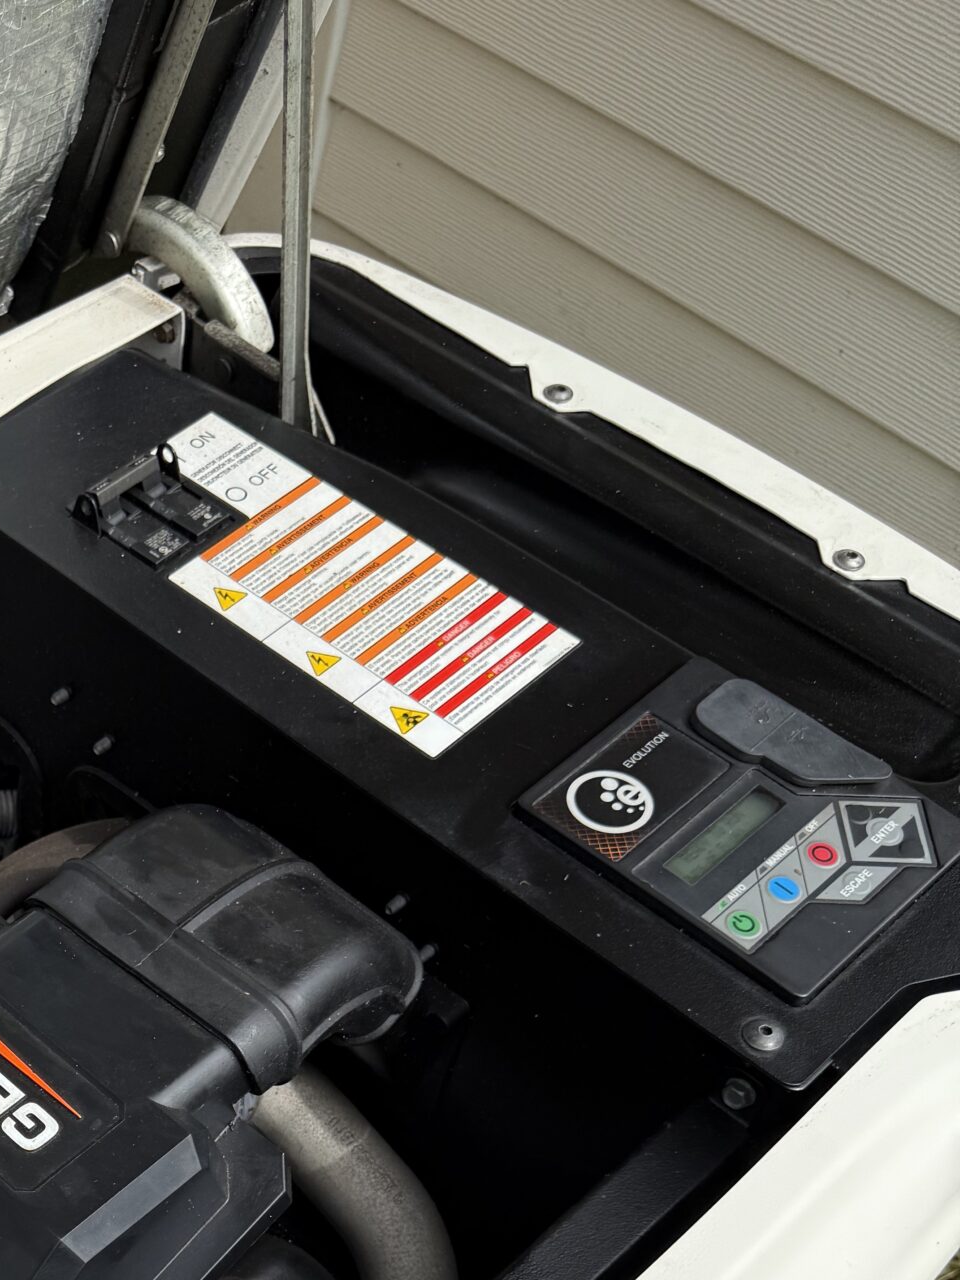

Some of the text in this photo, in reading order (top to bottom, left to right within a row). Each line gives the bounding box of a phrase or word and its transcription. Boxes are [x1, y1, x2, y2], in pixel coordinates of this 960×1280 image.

[190, 432, 216, 448] ON
[249, 463, 278, 486] OFF
[251, 504, 282, 525] WARNING
[274, 514, 326, 549] AVERTISSEMENT
[308, 537, 354, 568] ADVERTENCIA
[349, 561, 381, 583] WARNING
[365, 572, 419, 609] AVERTISSEMENT
[403, 596, 449, 628] ADVERTENCIA
[441, 619, 471, 641] DANGER
[466, 636, 496, 657] DANGER
[490, 650, 523, 674] PELIGRO
[622, 731, 670, 768] EVOLUTION
[804, 819, 819, 833] OFF
[871, 820, 899, 844] ENTER
[765, 843, 794, 867] MANUAL
[727, 884, 747, 902] AUTO
[840, 868, 873, 898] ESCAPE
